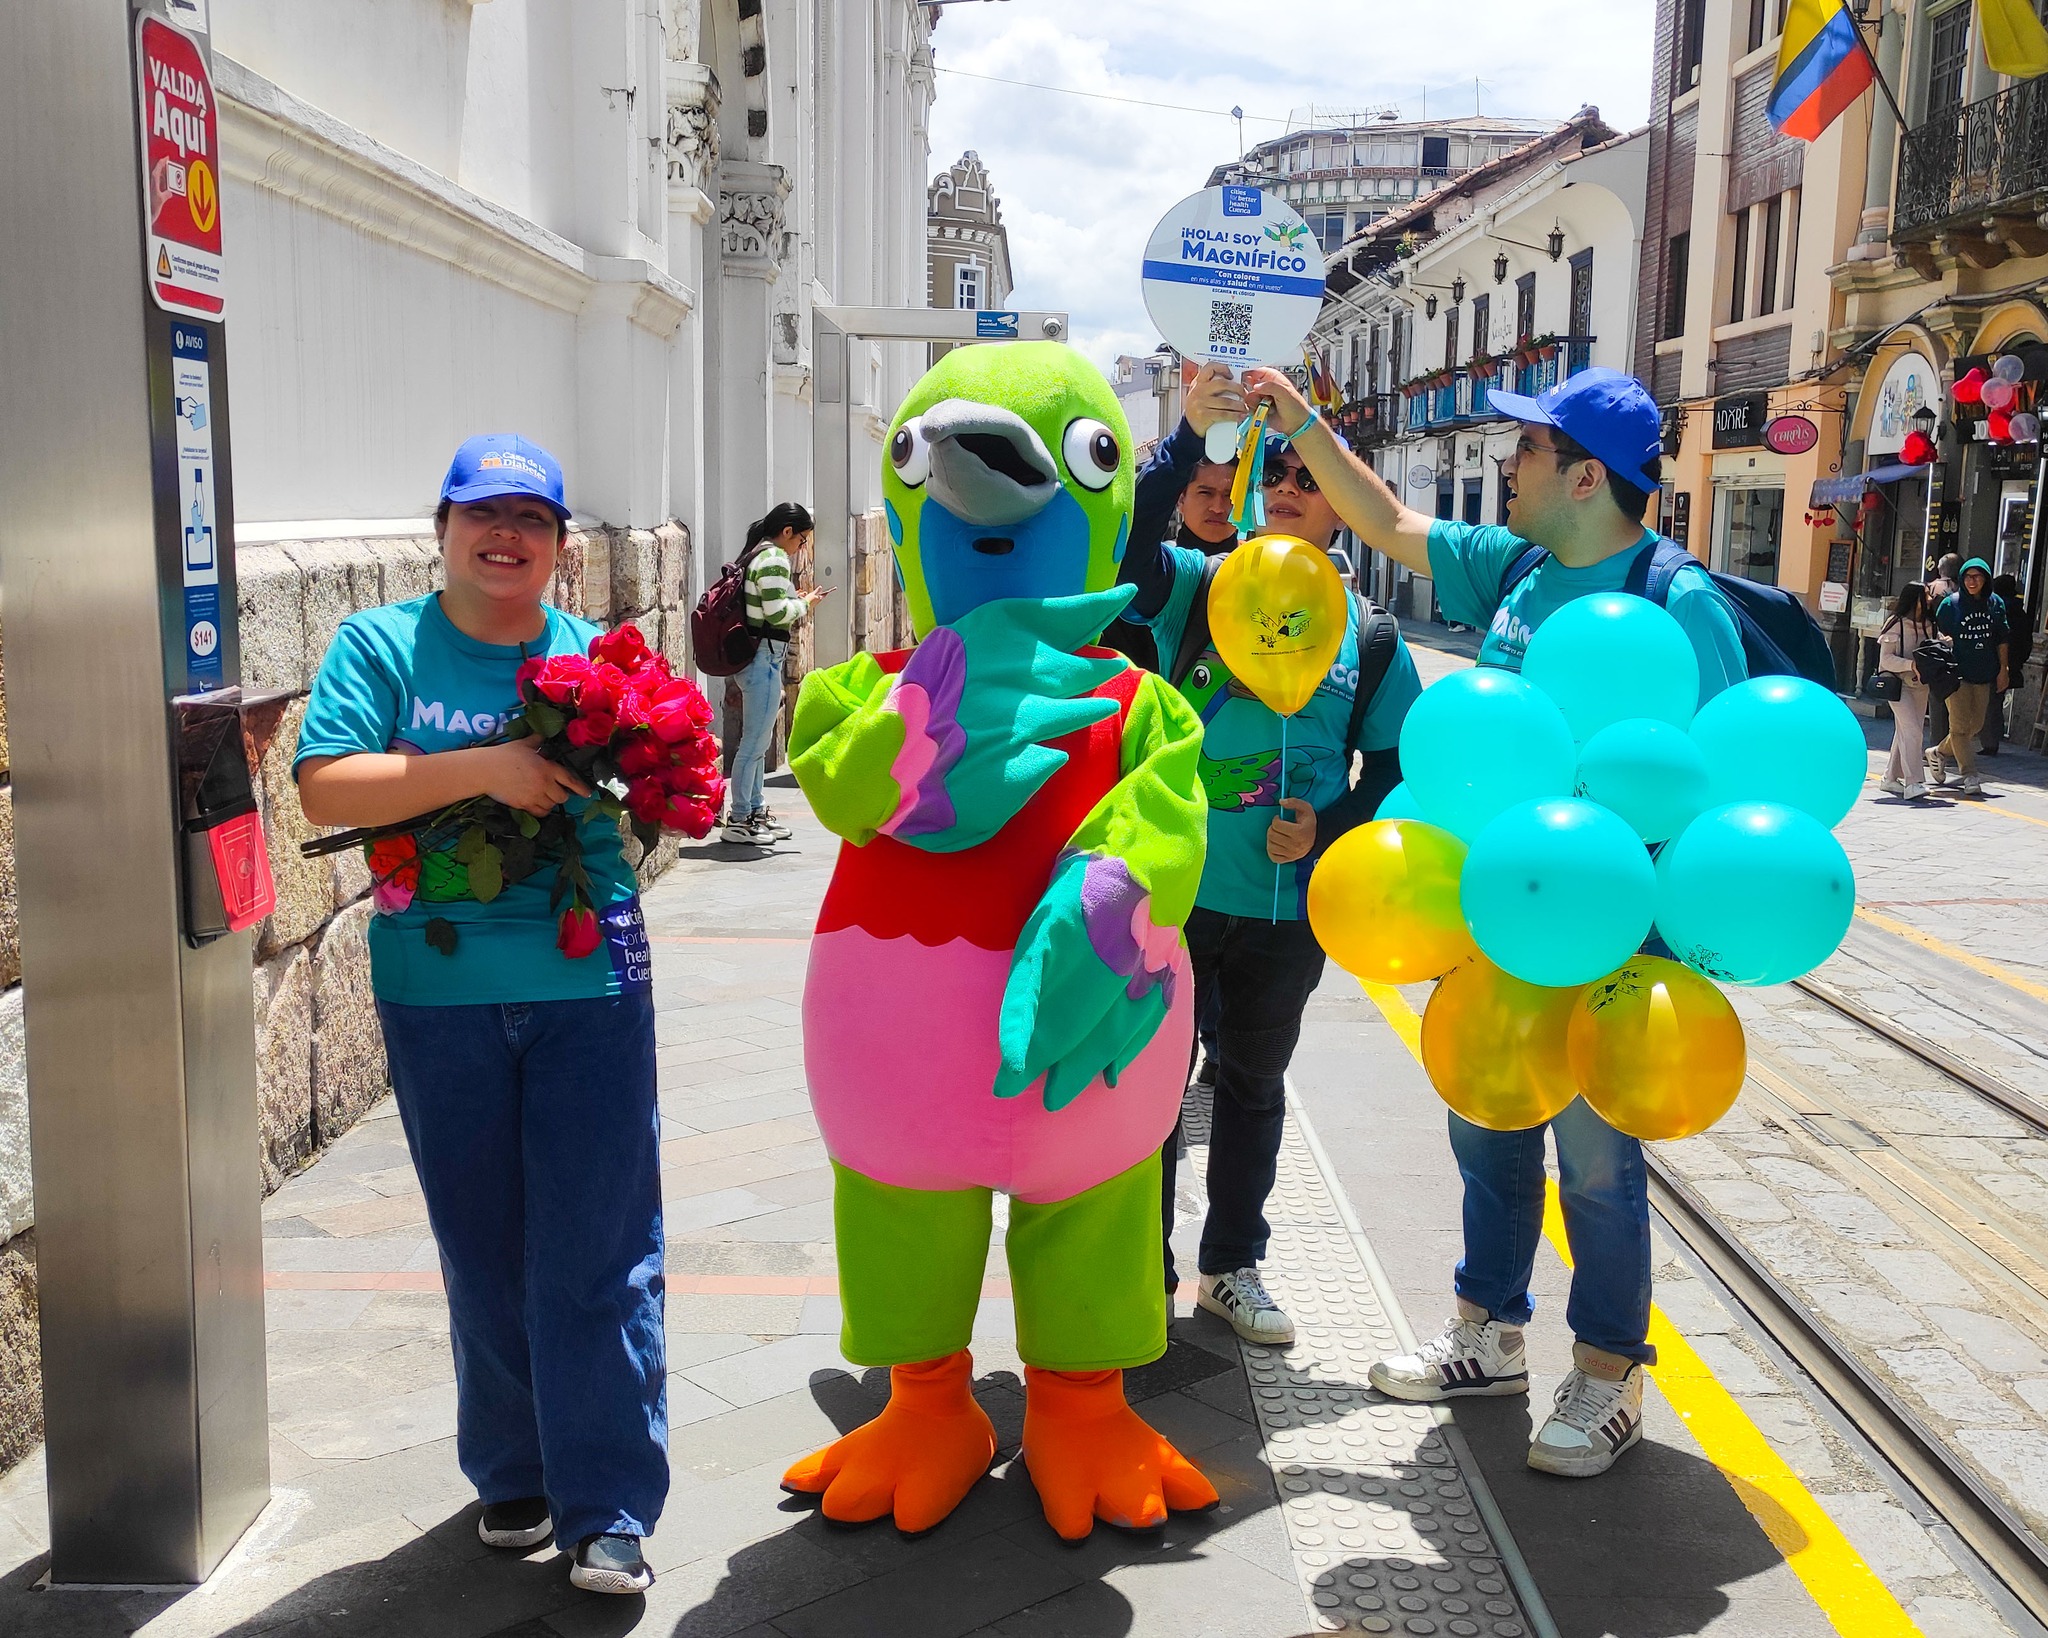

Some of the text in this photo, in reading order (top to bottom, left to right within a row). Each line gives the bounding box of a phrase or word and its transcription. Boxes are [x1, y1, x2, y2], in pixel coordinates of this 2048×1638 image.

[149, 55, 207, 111] VALIDA
[153, 89, 207, 158] Aquí
[1232, 233, 1262, 246] SOY
[1227, 279, 1248, 288] salud
[1233, 271, 1260, 282] colores
[185, 334, 203, 350] AVISO
[194, 629, 213, 649] $141
[1584, 1355, 1620, 1374] adidas
